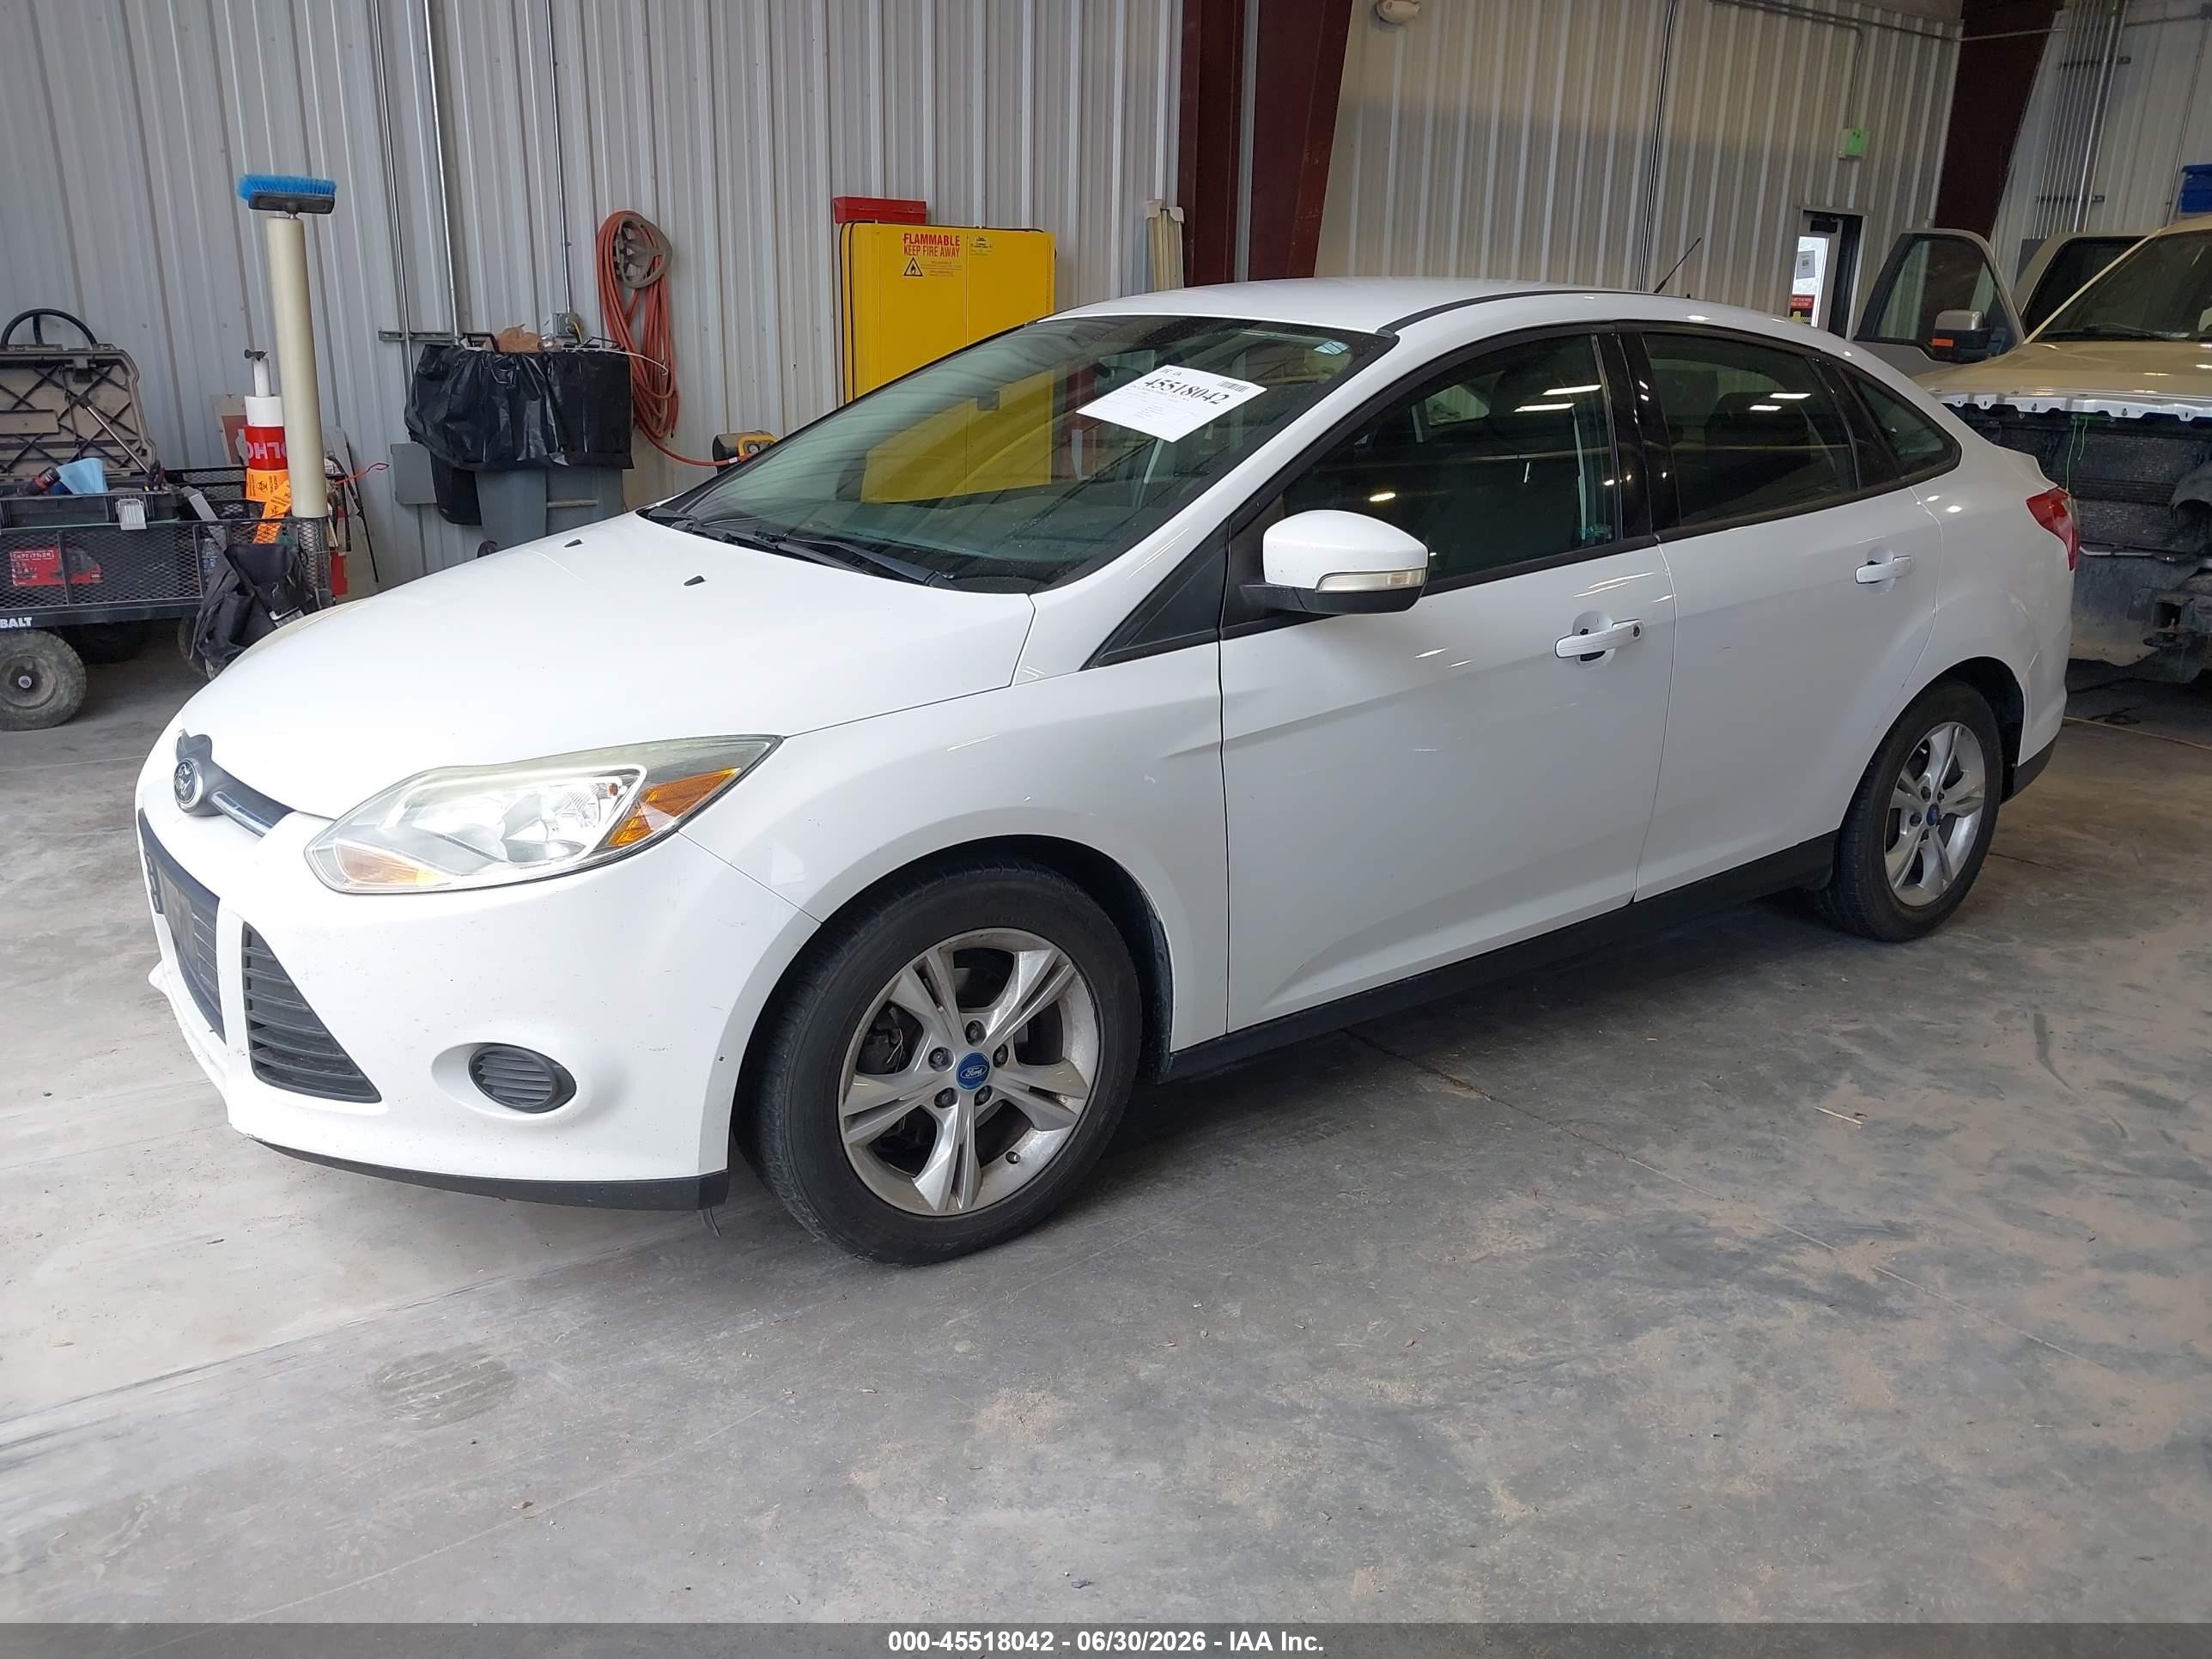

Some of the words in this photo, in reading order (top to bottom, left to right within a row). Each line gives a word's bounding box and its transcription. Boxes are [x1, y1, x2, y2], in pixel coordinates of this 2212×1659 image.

[903, 233, 961, 246] FLAMMABLE
[904, 246, 921, 256] KEEP
[923, 246, 939, 257] FIRE
[940, 246, 961, 258] AWAY
[1145, 378, 1230, 405] 45518042
